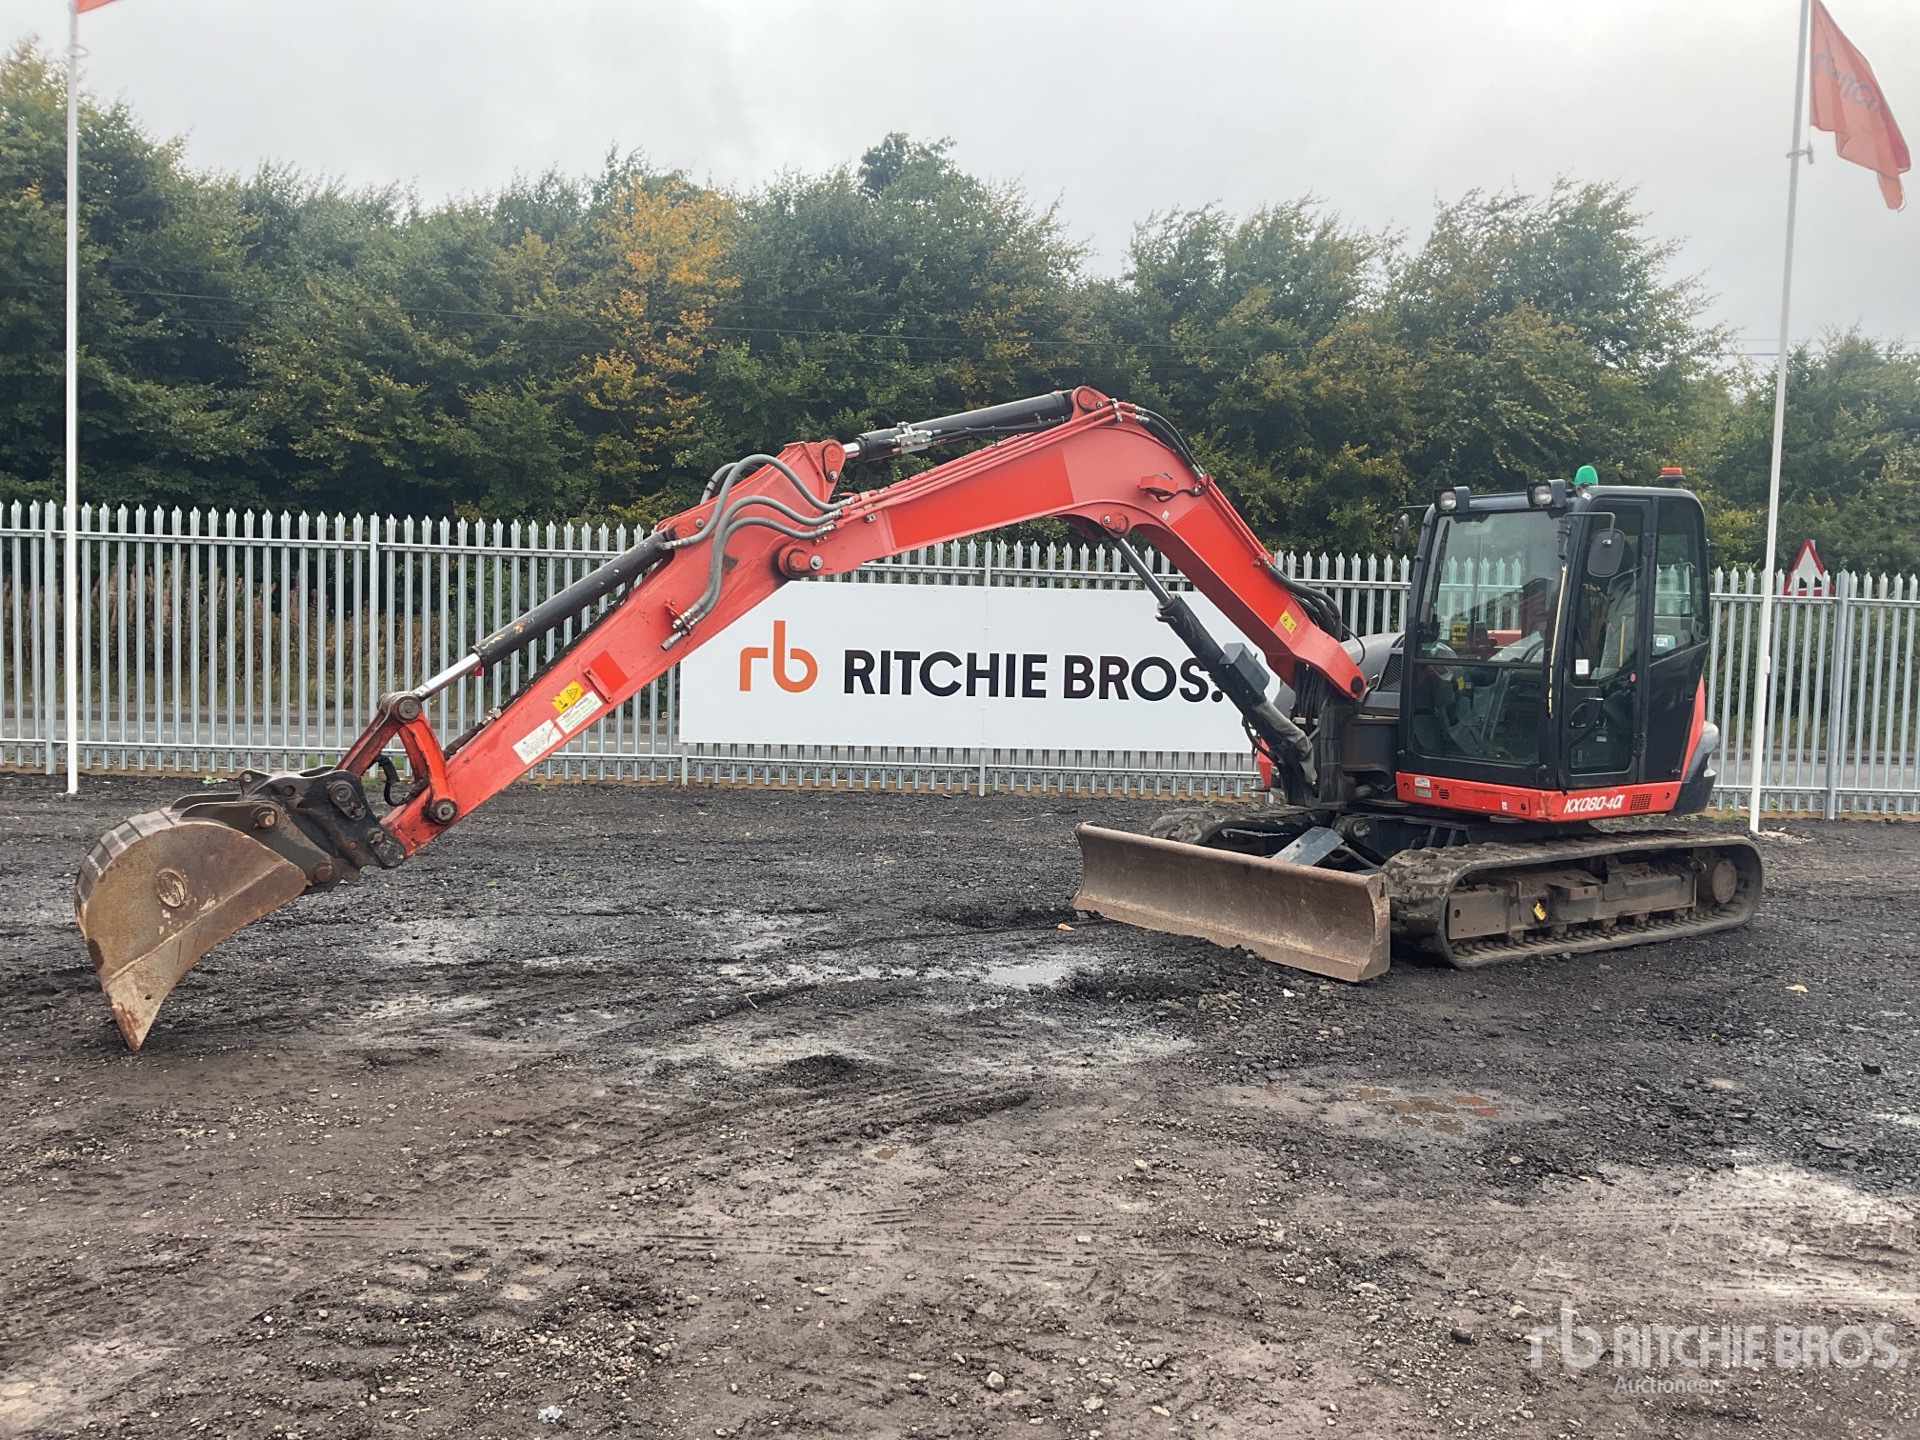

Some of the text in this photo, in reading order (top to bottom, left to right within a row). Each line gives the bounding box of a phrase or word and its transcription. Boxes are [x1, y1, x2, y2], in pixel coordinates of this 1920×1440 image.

[739, 620, 818, 693] rb
[843, 649, 1224, 703] RITCHIE BROS.
